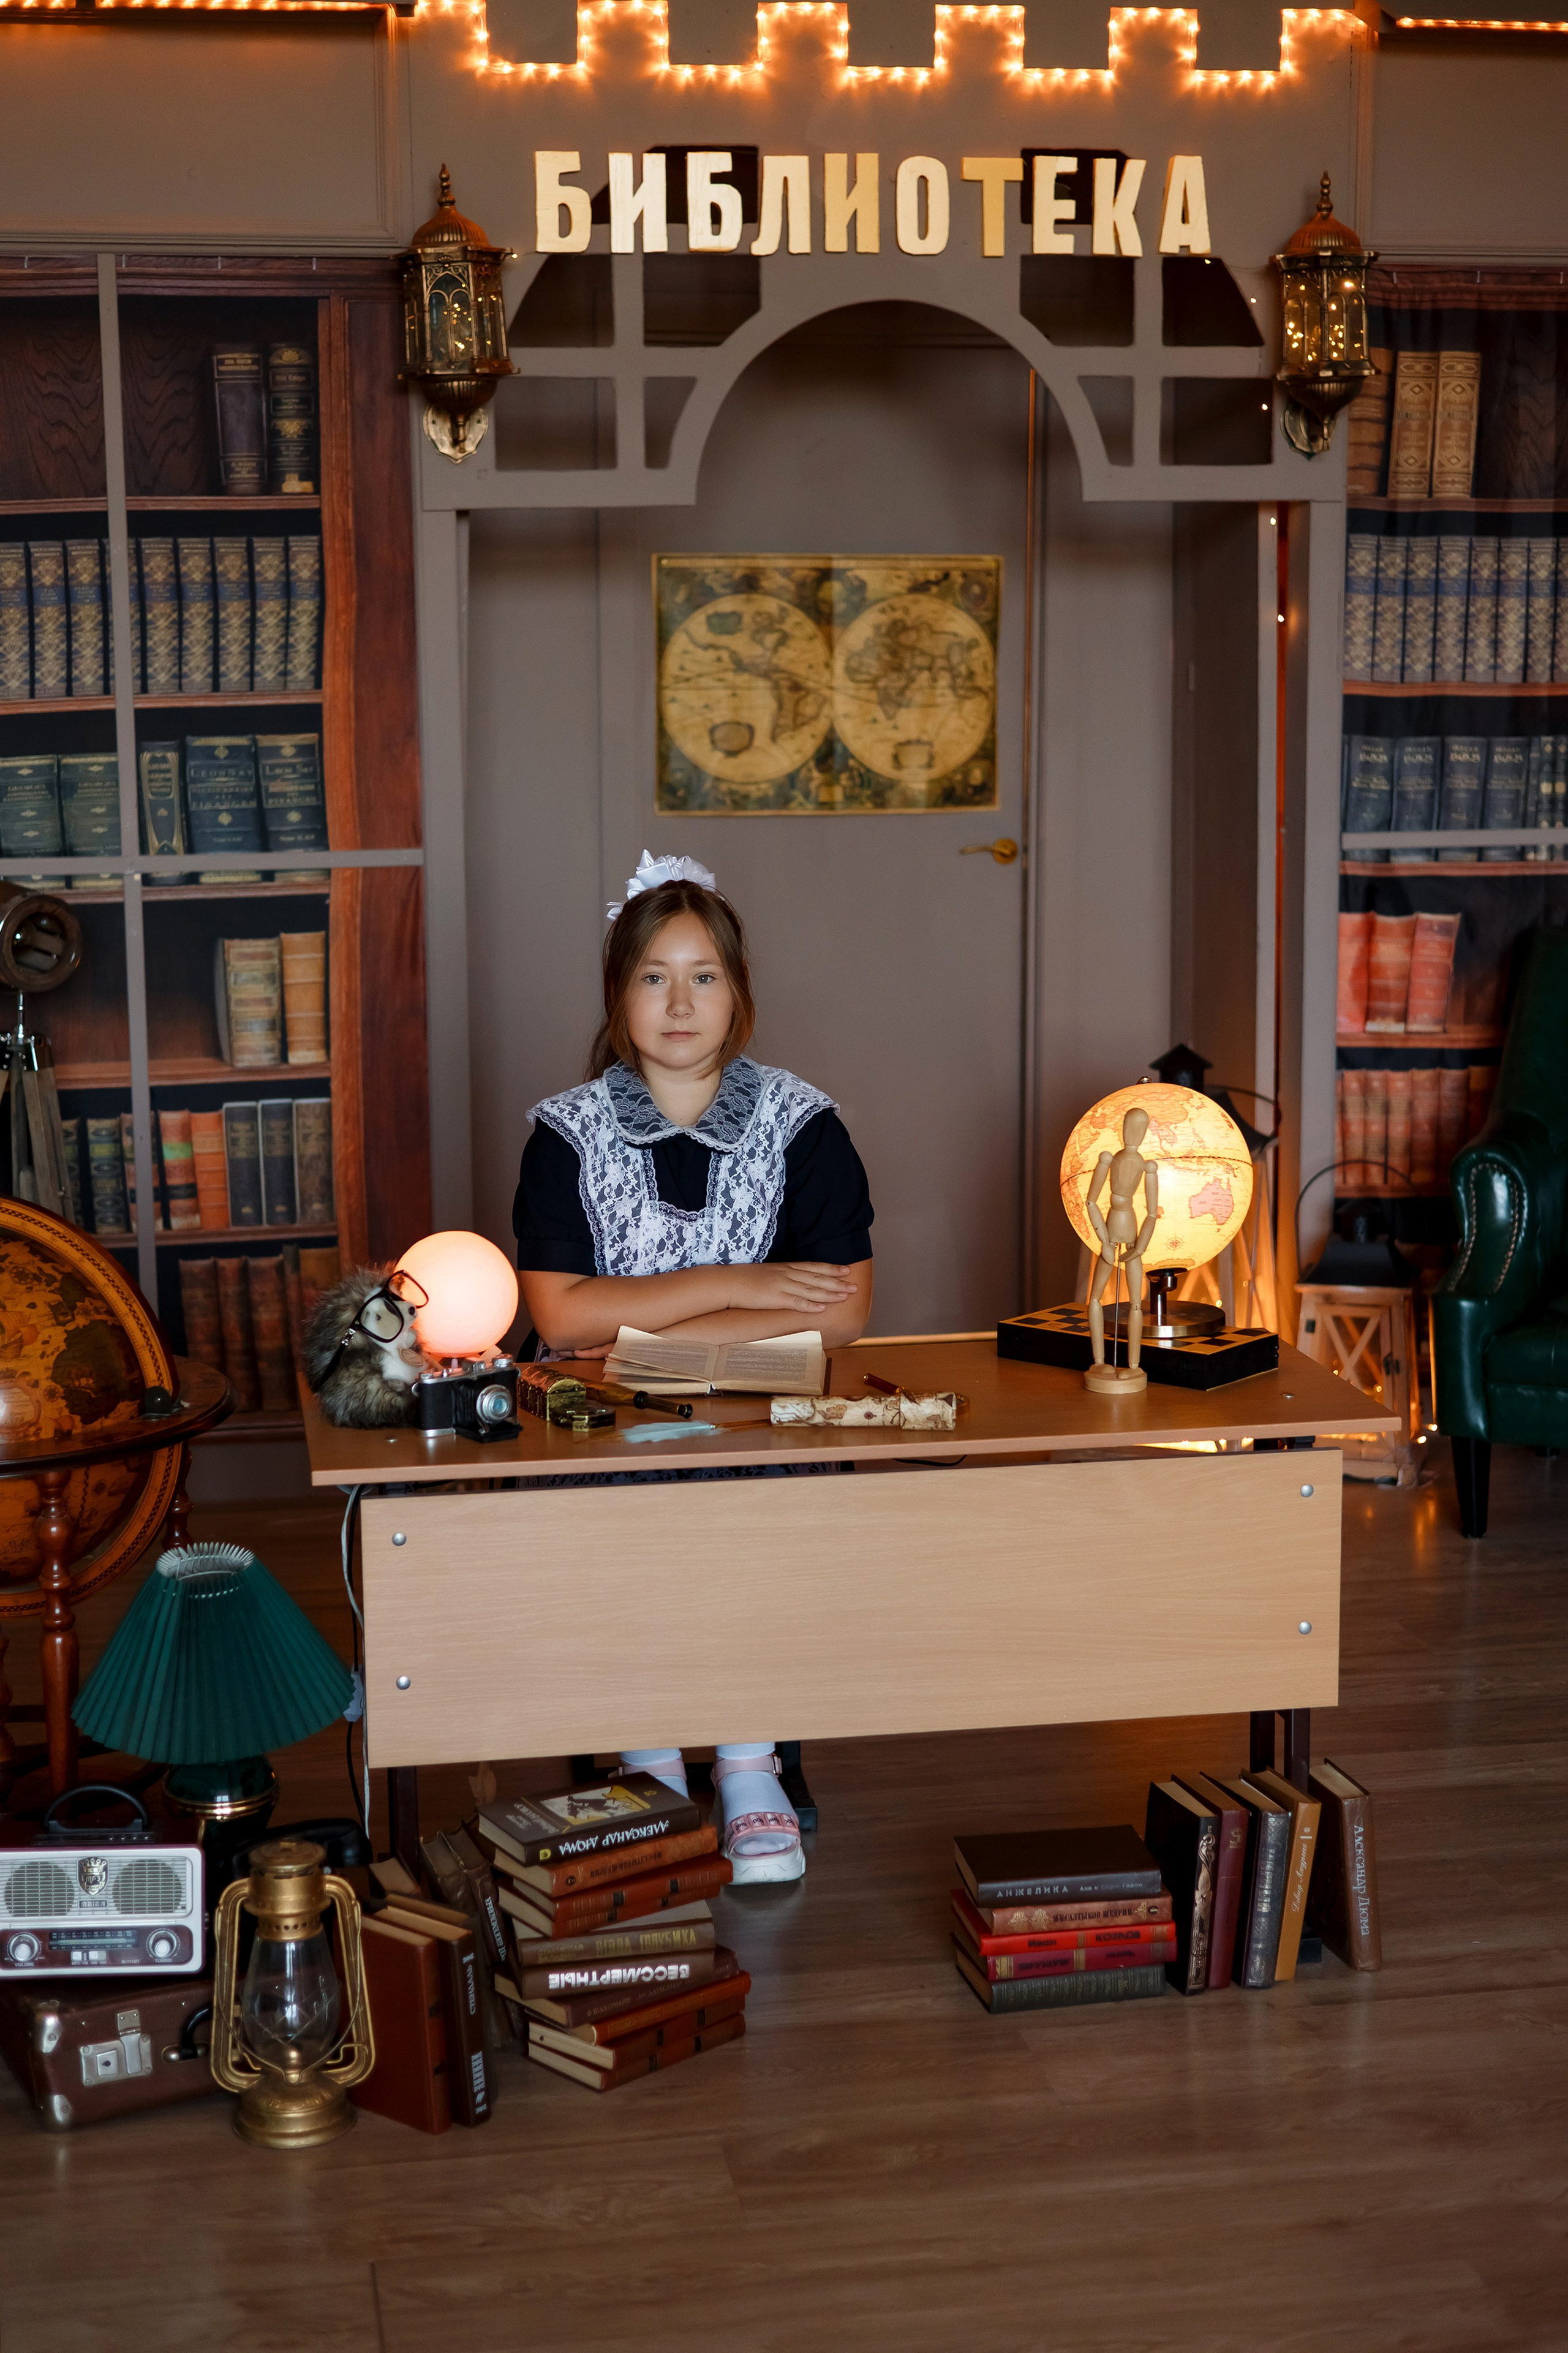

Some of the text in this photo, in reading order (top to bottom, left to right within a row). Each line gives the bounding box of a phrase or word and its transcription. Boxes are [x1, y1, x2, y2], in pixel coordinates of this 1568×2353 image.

[535, 150, 1212, 257] БИБЛИОТЕКА
[559, 1820, 669, 1856] АЛЕКСАНДР ДЮМА
[997, 1885, 1069, 1898] АНЖЕЛИКА
[1291, 1884, 1303, 1913] Дэвид
[1352, 1824, 1370, 1943] Александр Дюма
[467, 1964, 476, 2015] СТЕНДАЛЬ
[548, 1964, 690, 1989] БЕССМЕРТНЫЕ
